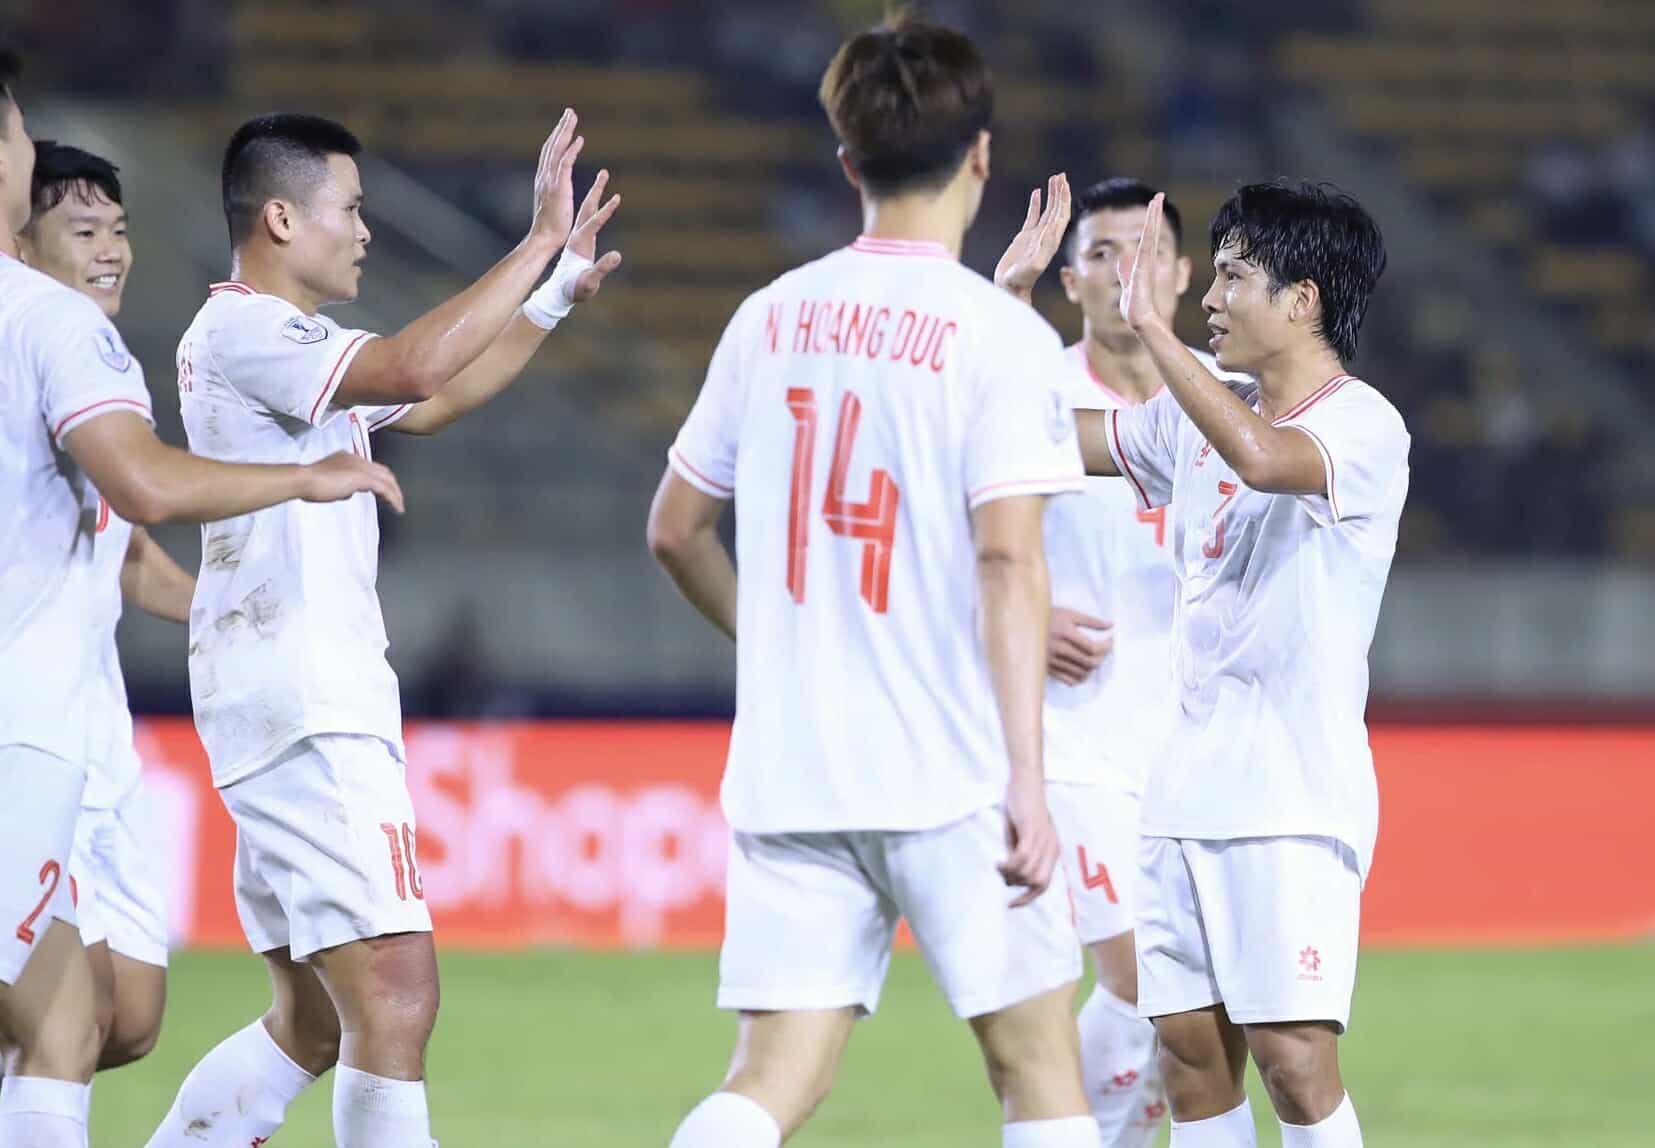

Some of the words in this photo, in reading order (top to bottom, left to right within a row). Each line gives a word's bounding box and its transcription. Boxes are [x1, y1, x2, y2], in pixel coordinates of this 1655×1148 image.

[765, 300, 784, 354] N
[792, 299, 889, 359] HOANG
[890, 307, 957, 374] DUC
[786, 387, 901, 615] 14
[16, 859, 62, 945] 2
[1077, 845, 1119, 905] 4
